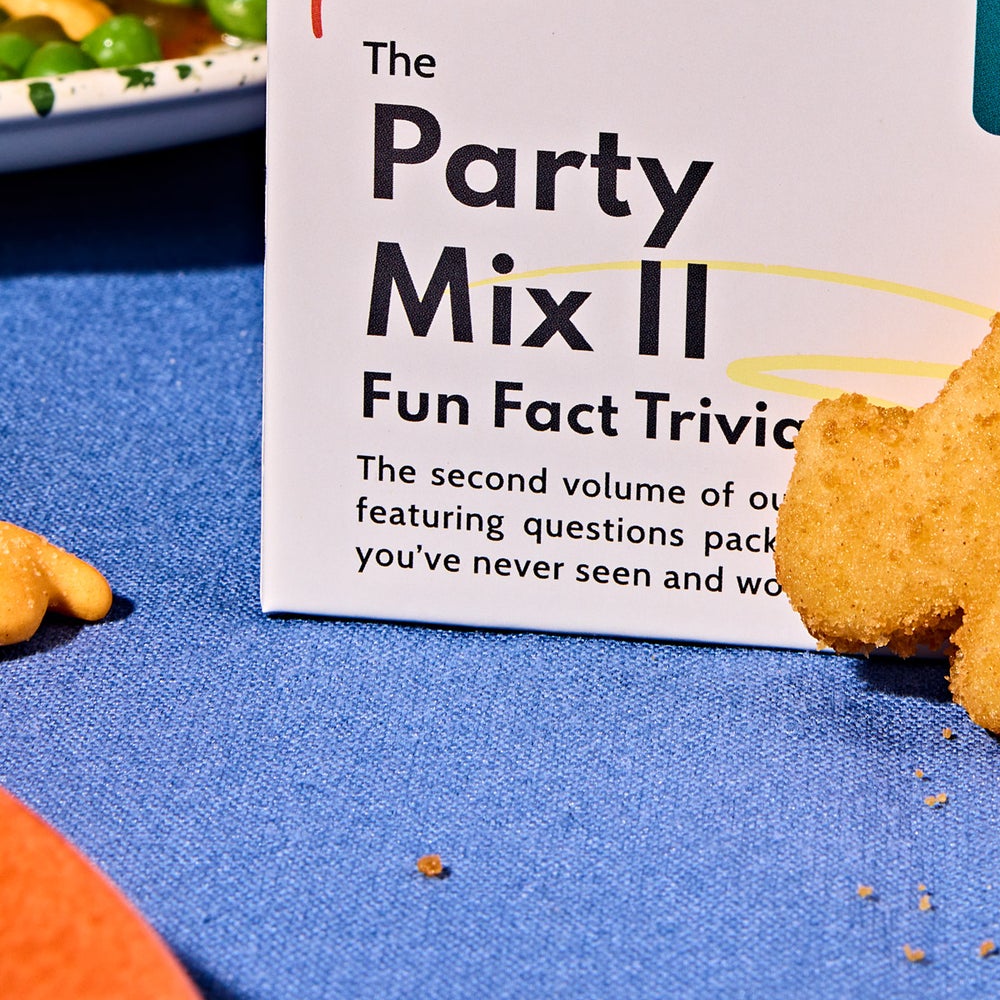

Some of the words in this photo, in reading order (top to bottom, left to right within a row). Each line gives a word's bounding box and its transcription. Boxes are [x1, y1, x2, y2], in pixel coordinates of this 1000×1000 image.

[363, 41, 437, 79] The
[373, 102, 714, 248] Party
[366, 241, 594, 352] Mix
[638, 259, 708, 360] II
[362, 371, 469, 426] Fun
[494, 381, 618, 437] Fact
[357, 454, 416, 485] The
[430, 457, 547, 494] second
[563, 472, 686, 505] volume
[701, 480, 735, 508] of
[356, 497, 504, 541] featuring
[523, 515, 684, 554] questions
[355, 542, 460, 574] you’ve
[473, 553, 565, 581] never
[576, 558, 652, 588] seen
[663, 566, 723, 594] and
